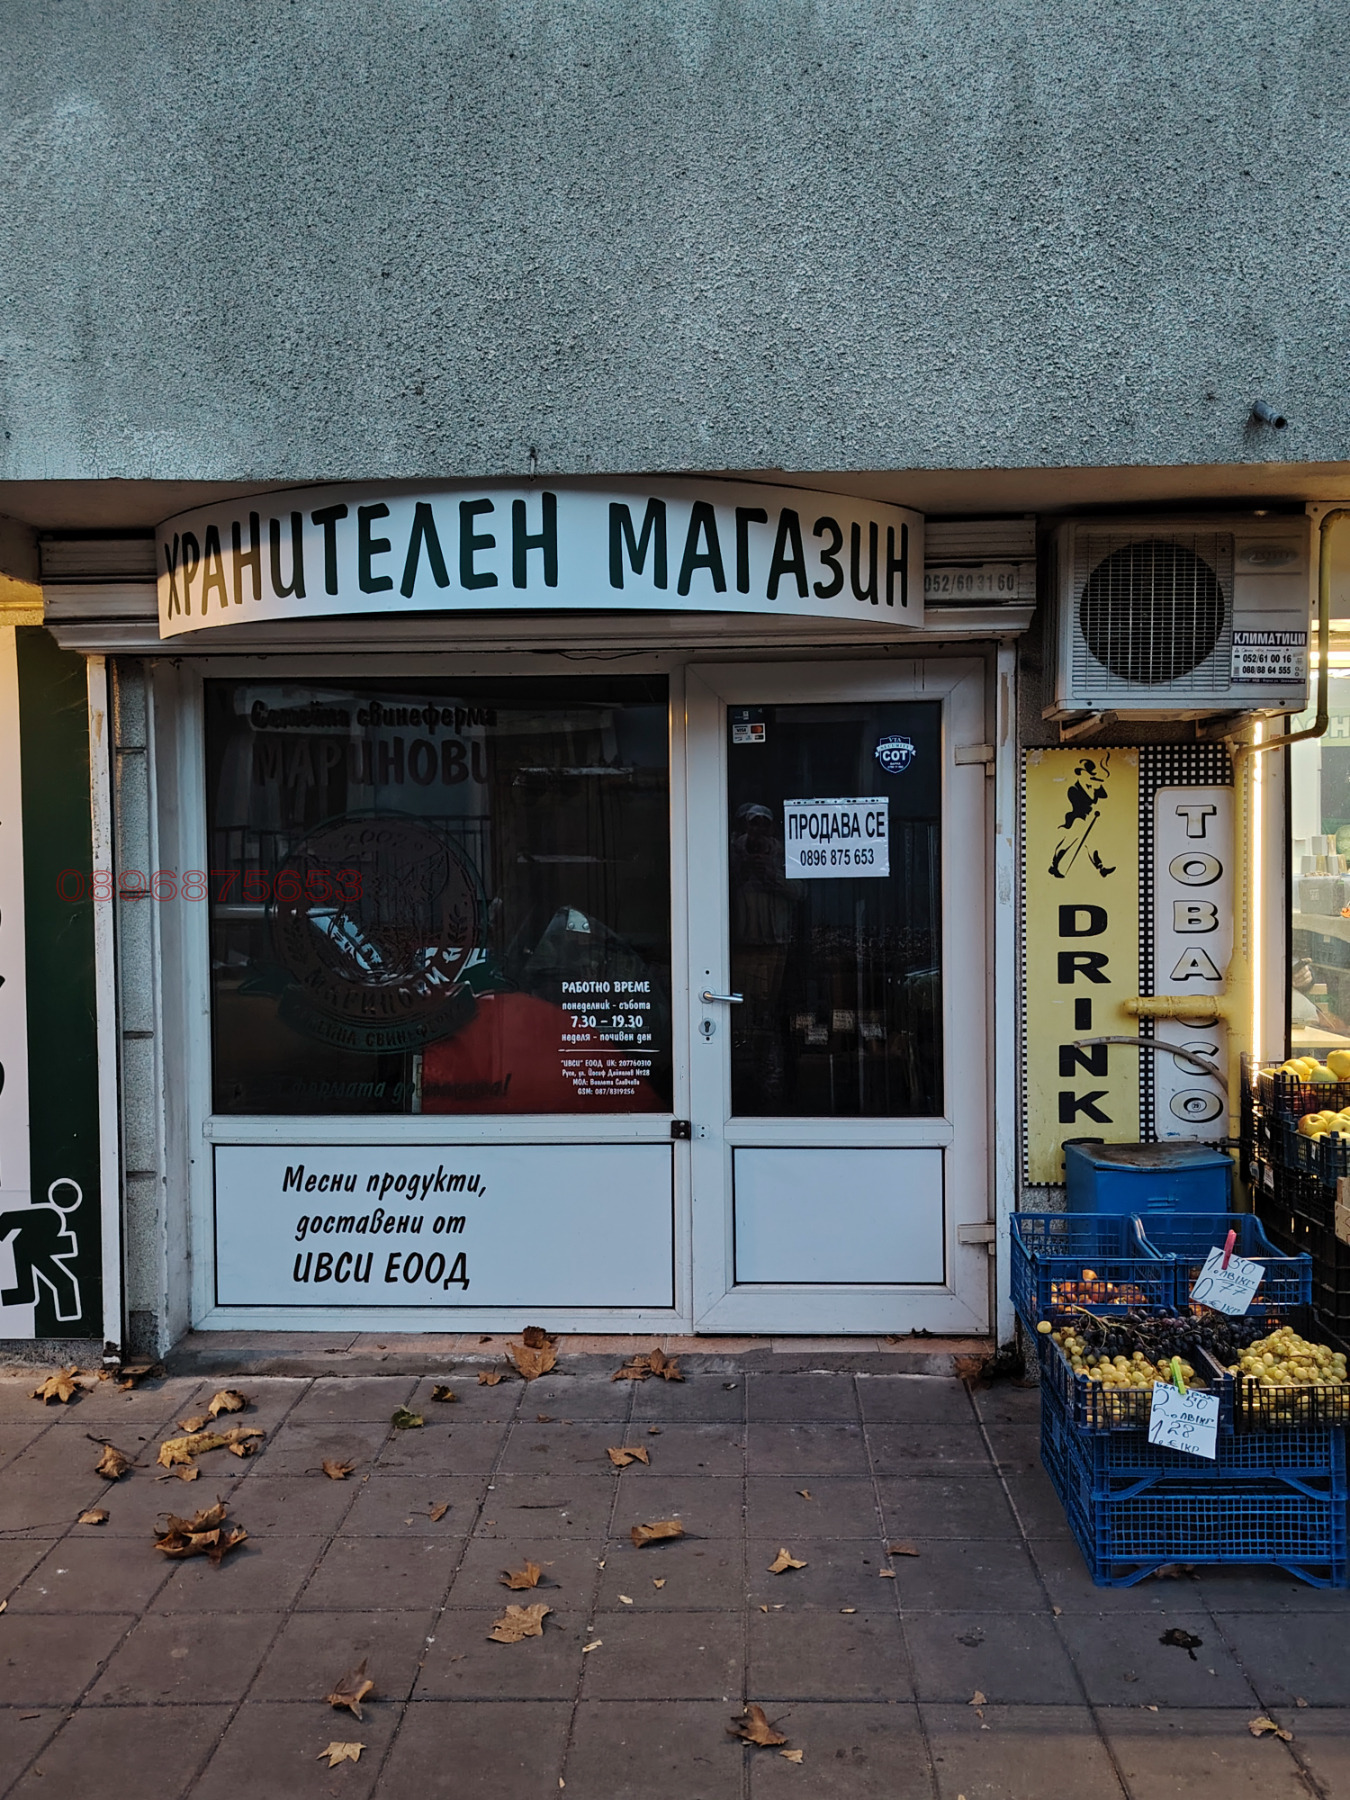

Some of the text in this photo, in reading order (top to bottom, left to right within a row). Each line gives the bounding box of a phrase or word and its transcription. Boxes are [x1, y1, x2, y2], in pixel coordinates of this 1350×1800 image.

[164, 492, 908, 620] ХРАНИТЕЛЕН МАГАЗИН
[997, 573, 1014, 591] 60
[1234, 632, 1306, 645] КЛИМАТИЦИ
[1243, 654, 1292, 663] 052/61 00 16
[1267, 666, 1276, 674] 64
[1278, 666, 1291, 675] 555
[357, 701, 497, 735] свинеферма
[253, 737, 496, 786] МАРИНОВИ
[789, 811, 886, 844] ПРОДАВА СЕ
[800, 848, 874, 866] 0896 875 653
[562, 981, 651, 993] РАБОТНО ВРЕМЕ
[562, 999, 610, 1012] понеделник
[619, 999, 651, 1010] събота
[570, 1015, 596, 1028] 7.30
[612, 1015, 643, 1028] 19.30
[1057, 904, 1114, 1152] DRINK
[561, 1033, 591, 1044] неделя
[600, 1031, 634, 1041] почивен
[637, 1033, 652, 1044] ден
[585, 1060, 603, 1068] ЕООД
[282, 1164, 486, 1201] Месни продукти,
[294, 1207, 466, 1242] доставени от
[293, 1251, 470, 1291] ИВСИ ЕООД
